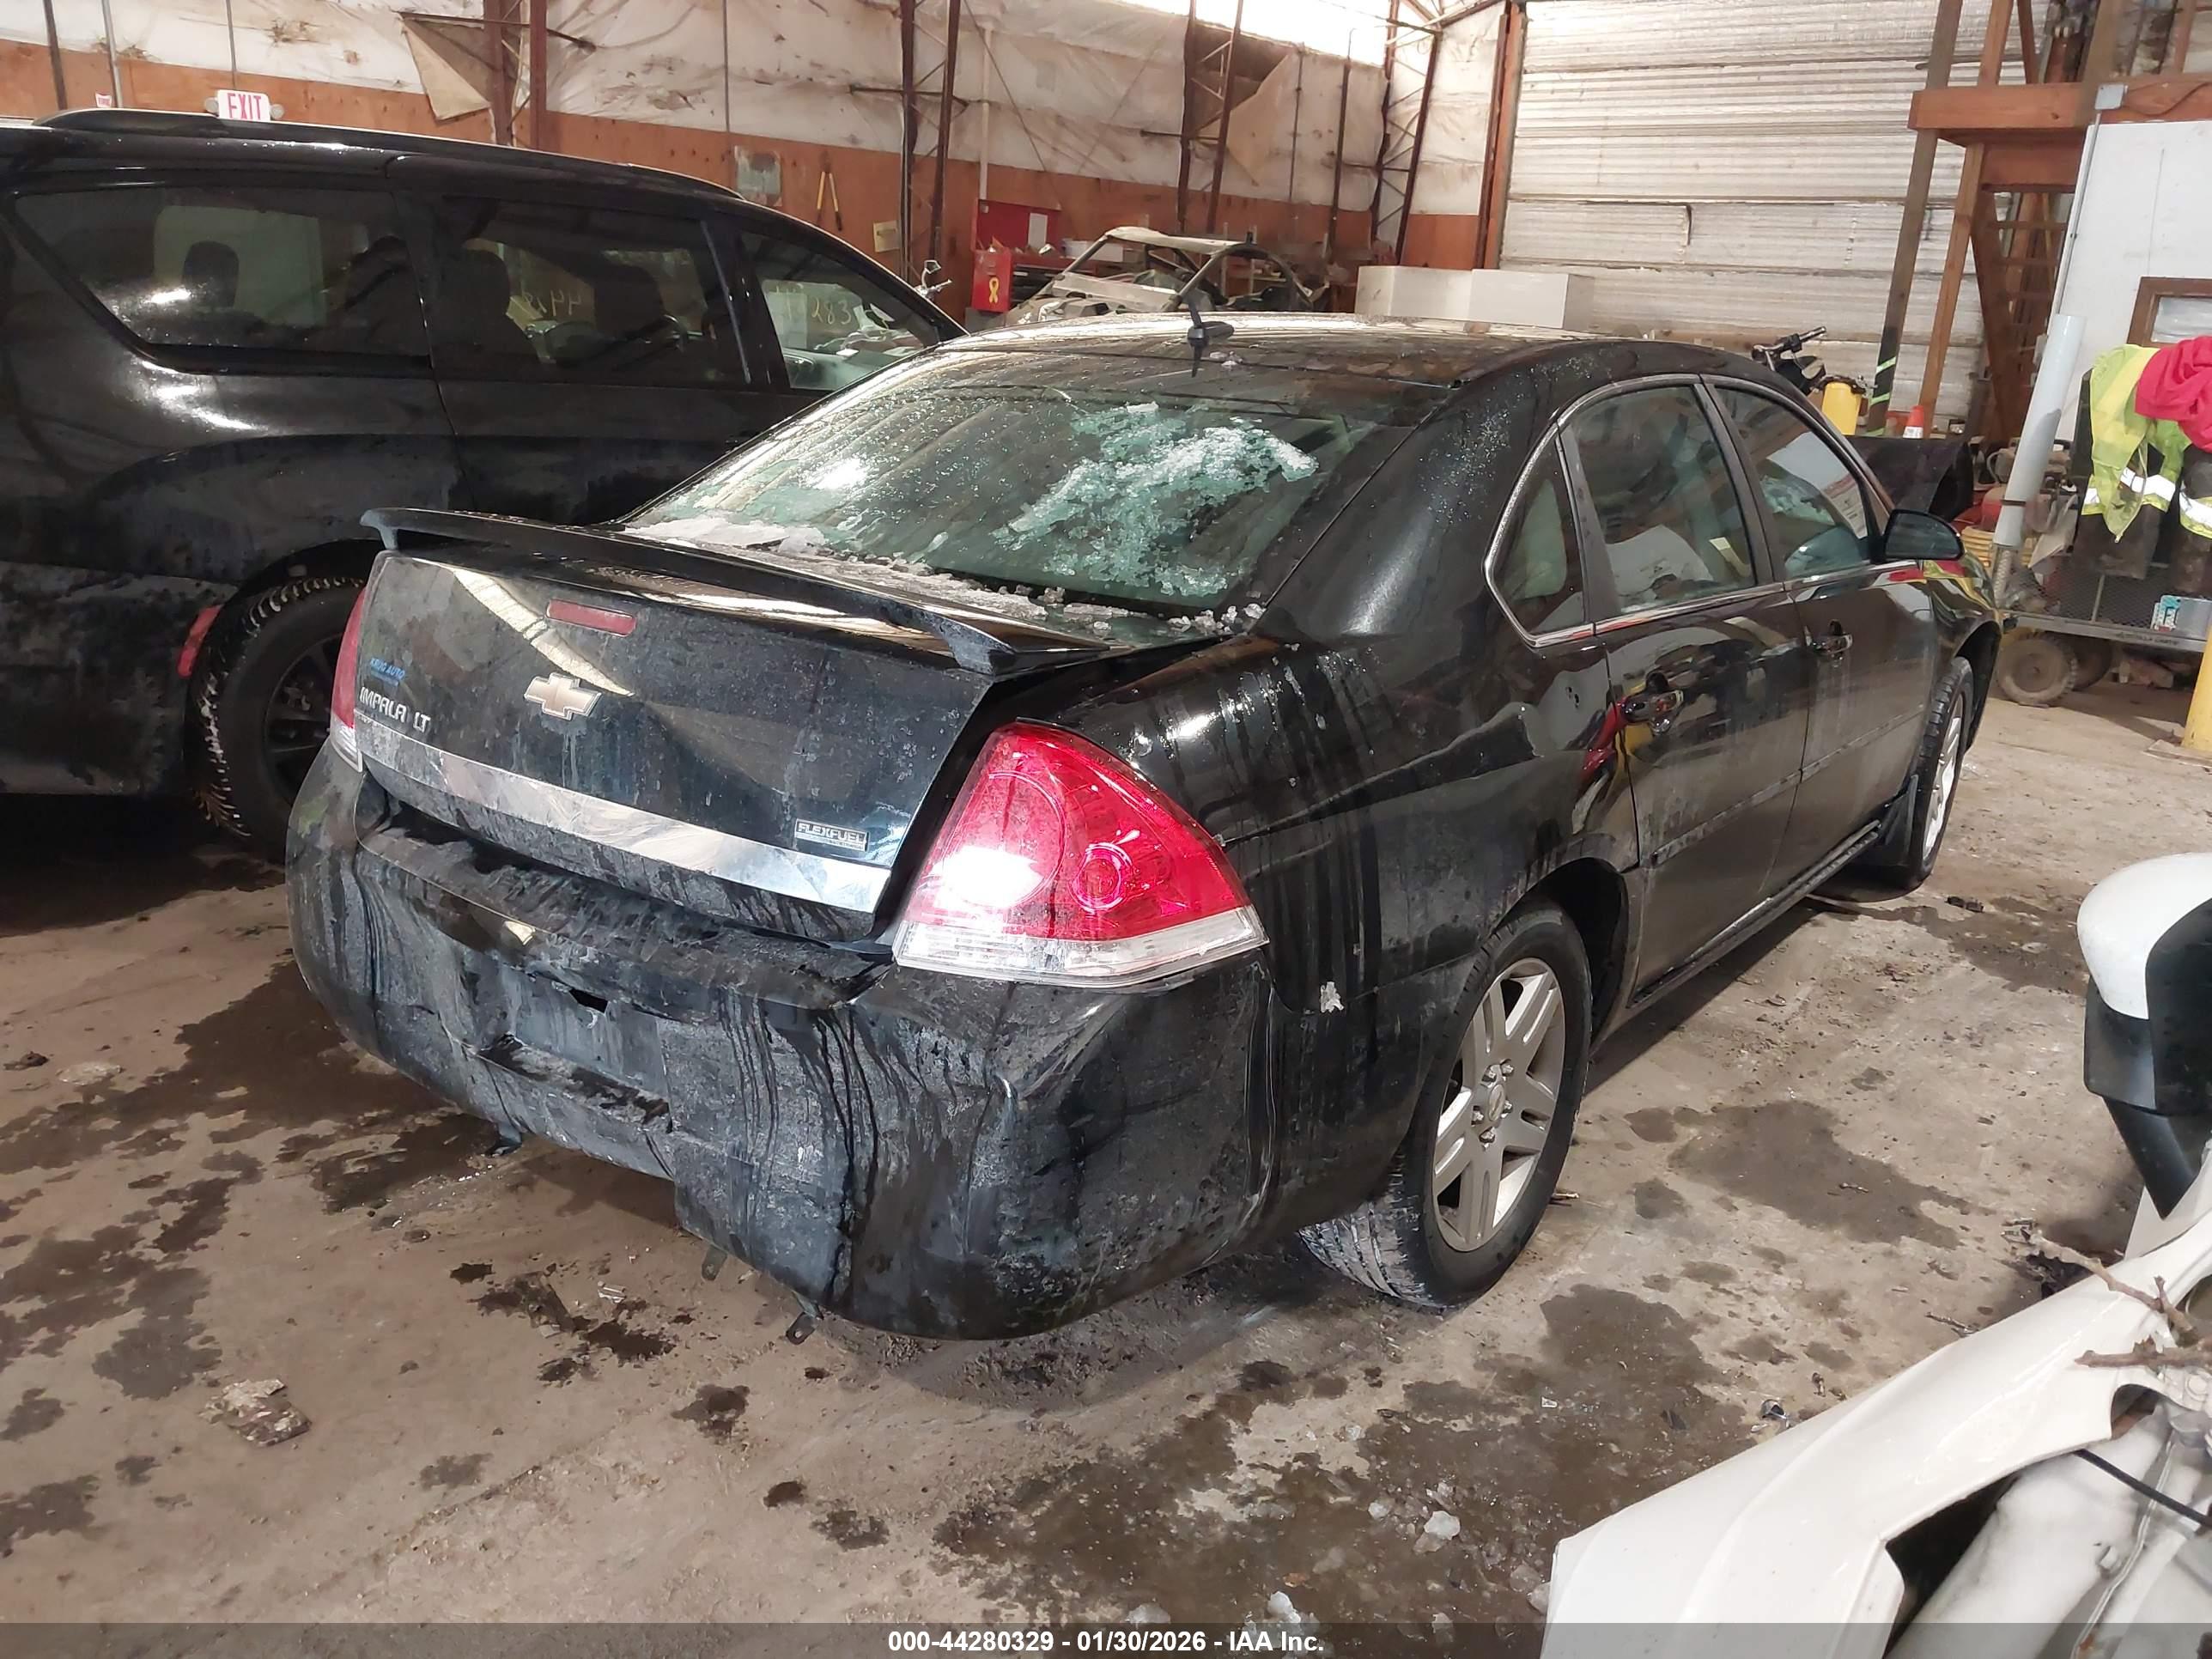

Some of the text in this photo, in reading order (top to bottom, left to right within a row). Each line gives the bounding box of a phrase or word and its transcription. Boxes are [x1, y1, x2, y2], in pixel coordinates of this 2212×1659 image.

[227, 93, 262, 120] EXIT
[386, 665, 406, 681] AUTO
[359, 686, 432, 733] IMPALA LT
[798, 822, 866, 843] FLEXFUEL
